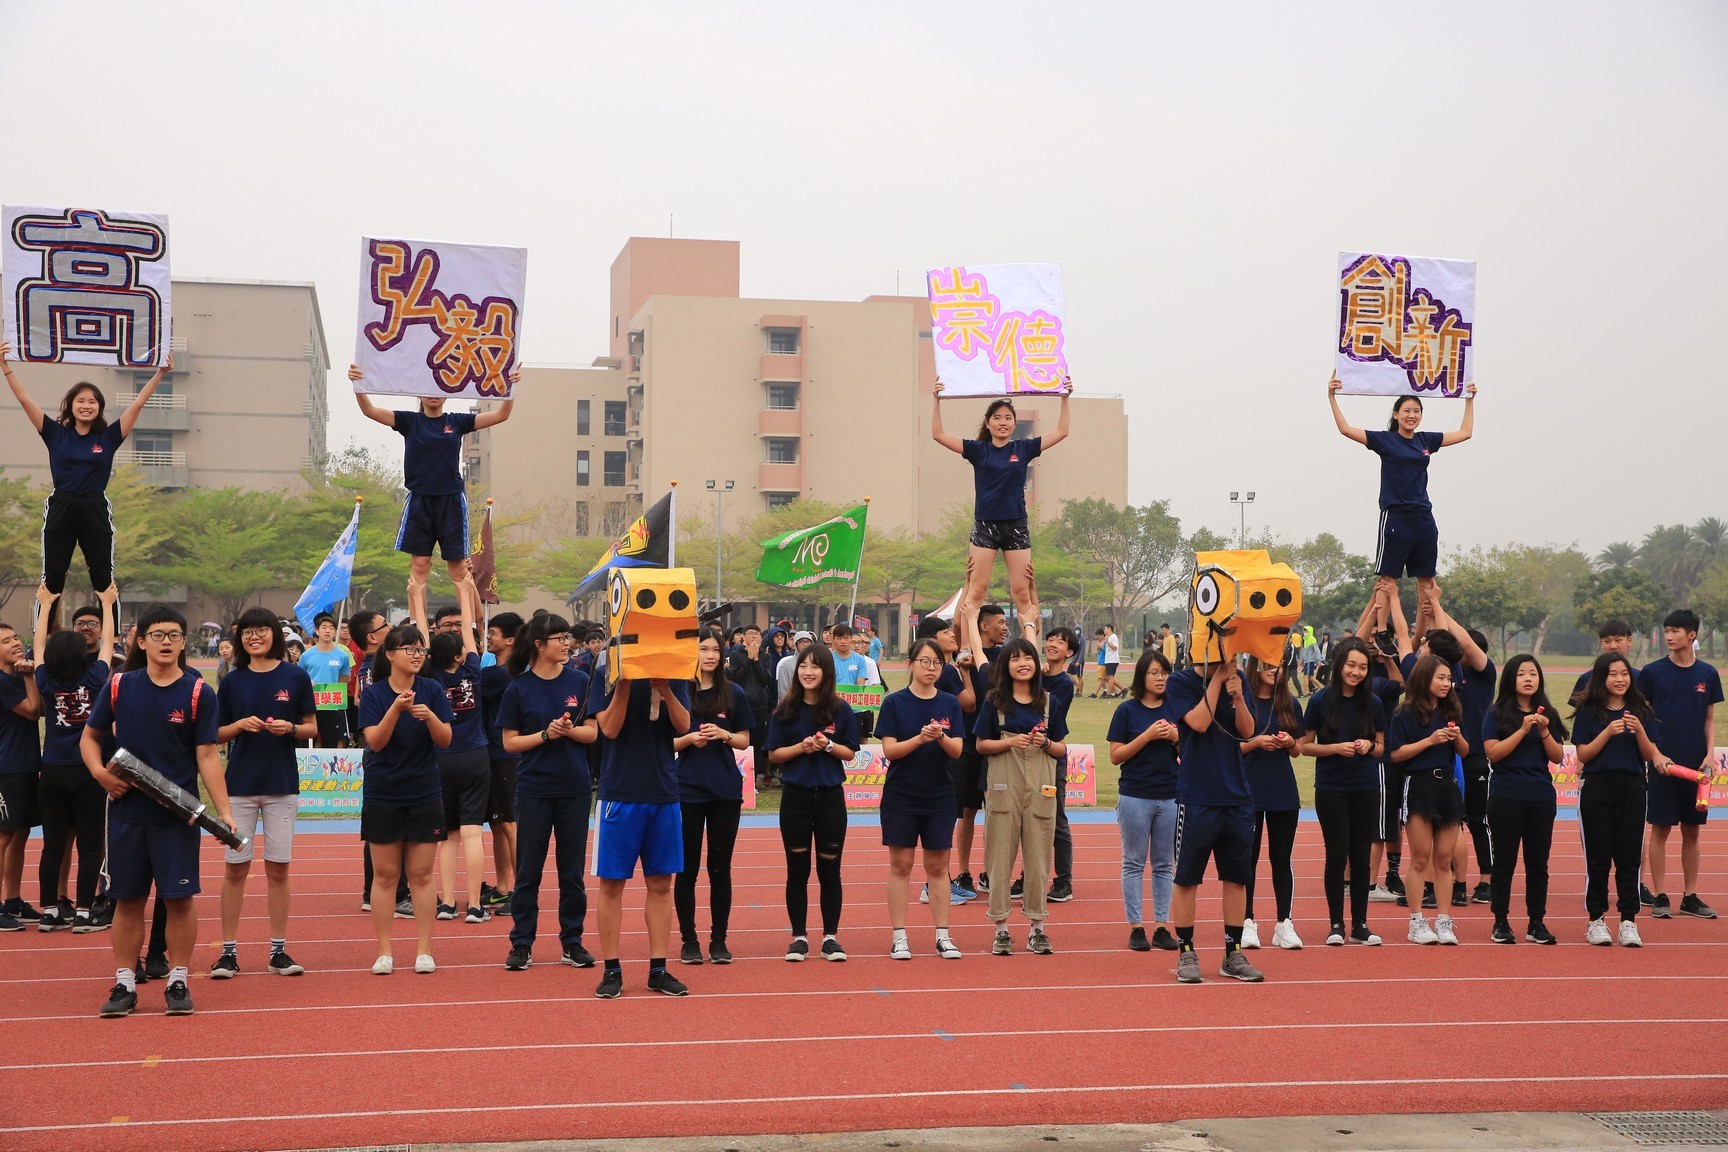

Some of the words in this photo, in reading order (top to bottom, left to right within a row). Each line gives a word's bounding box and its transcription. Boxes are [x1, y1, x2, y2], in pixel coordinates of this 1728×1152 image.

[12, 208, 167, 367] 高
[366, 240, 517, 397] 弘毅
[929, 267, 1067, 392] 崇德
[1340, 255, 1472, 396] 創新
